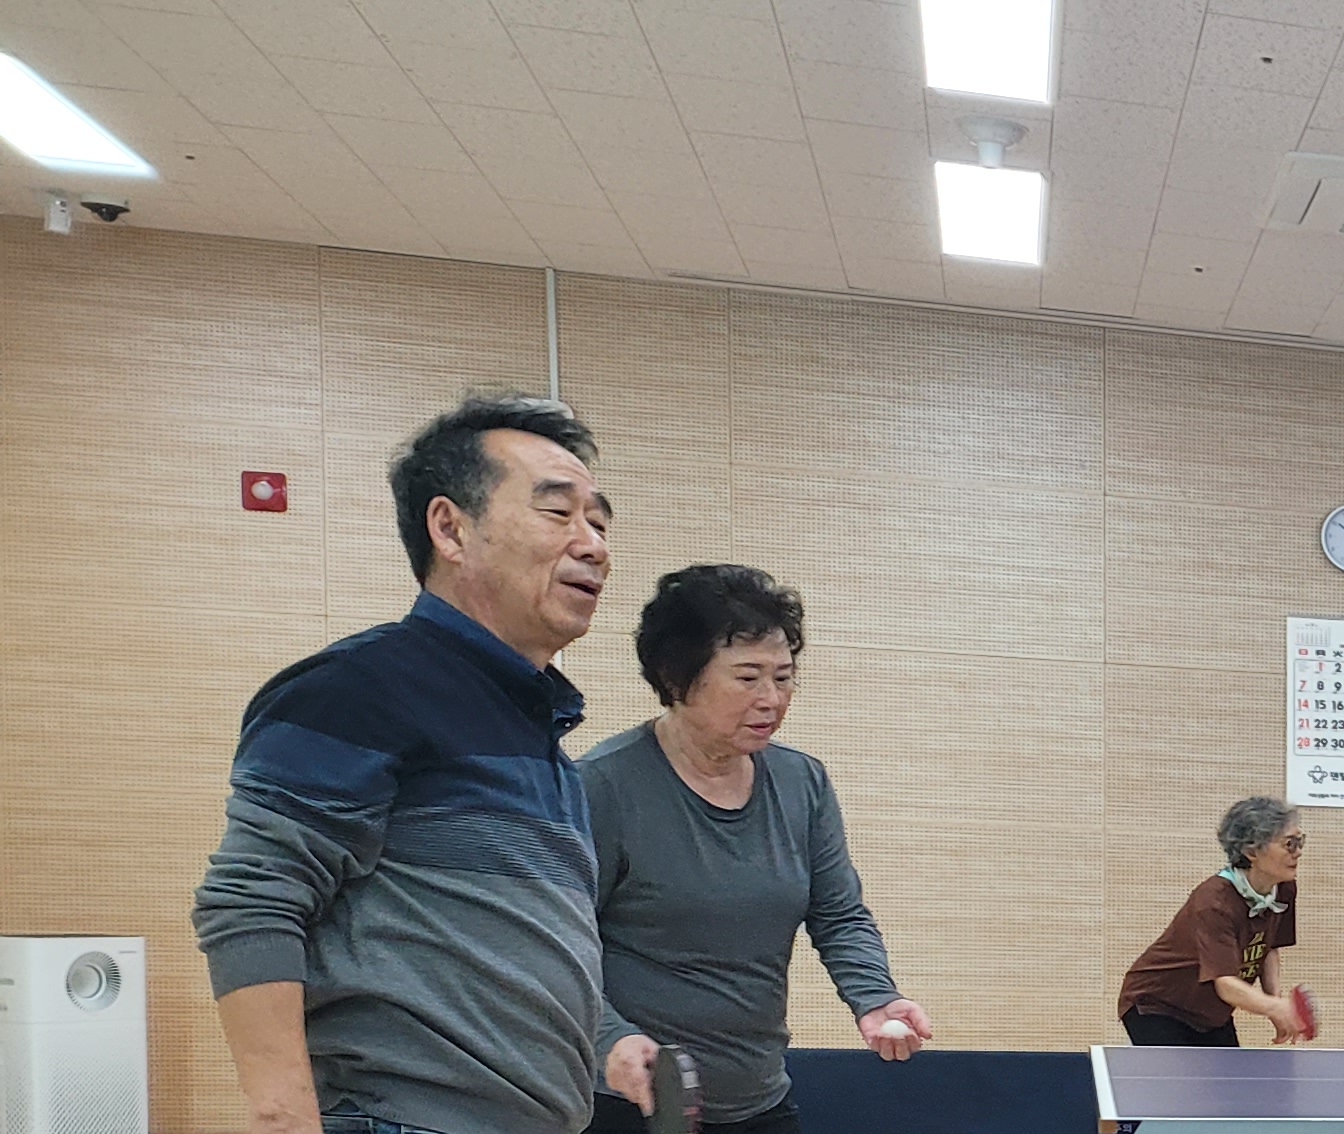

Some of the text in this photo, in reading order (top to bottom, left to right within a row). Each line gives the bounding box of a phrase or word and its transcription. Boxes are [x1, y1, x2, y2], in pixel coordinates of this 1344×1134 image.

[1317, 662, 1324, 672] 1
[1334, 663, 1342, 673] 2
[1300, 680, 1307, 690] 7
[1316, 681, 1324, 691] 8
[1334, 682, 1342, 692] 9
[1297, 699, 1309, 709] 14
[1315, 700, 1327, 710] 15
[1332, 701, 1344, 711] 16
[1298, 718, 1309, 728] 21
[1314, 719, 1328, 729] 22
[1331, 720, 1344, 730] 23
[1297, 737, 1310, 747] 28
[1313, 738, 1328, 748] 29
[1331, 739, 1344, 749] 30
